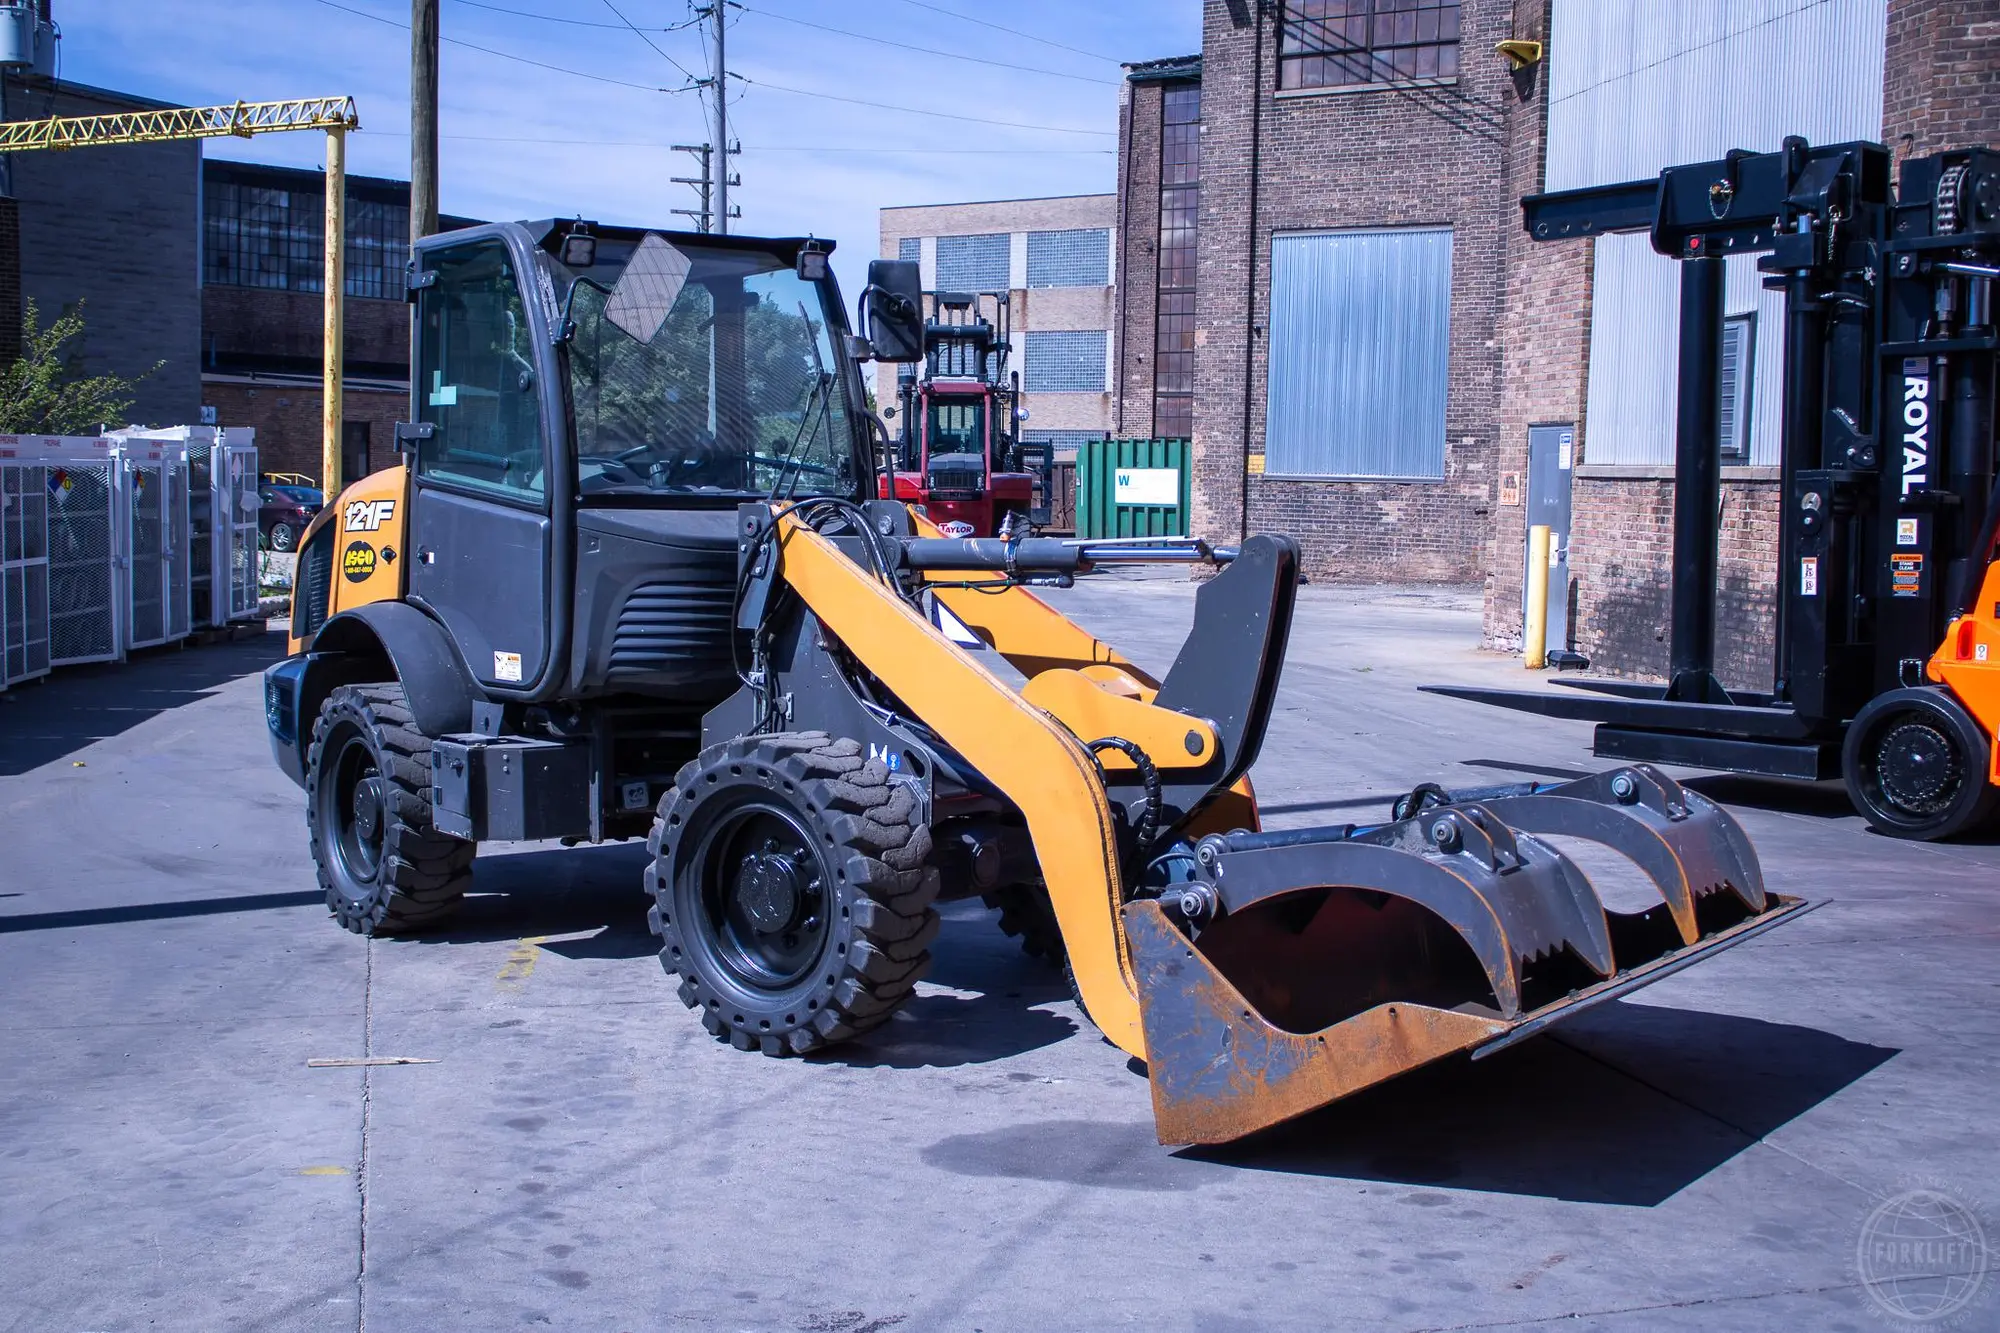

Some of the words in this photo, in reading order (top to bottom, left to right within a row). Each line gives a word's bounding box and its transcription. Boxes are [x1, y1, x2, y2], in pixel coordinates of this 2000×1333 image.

[1902, 377, 1929, 495] ROYAL
[1118, 474, 1130, 486] W
[345, 500, 396, 532] 121F
[940, 523, 972, 534] TAYLOR
